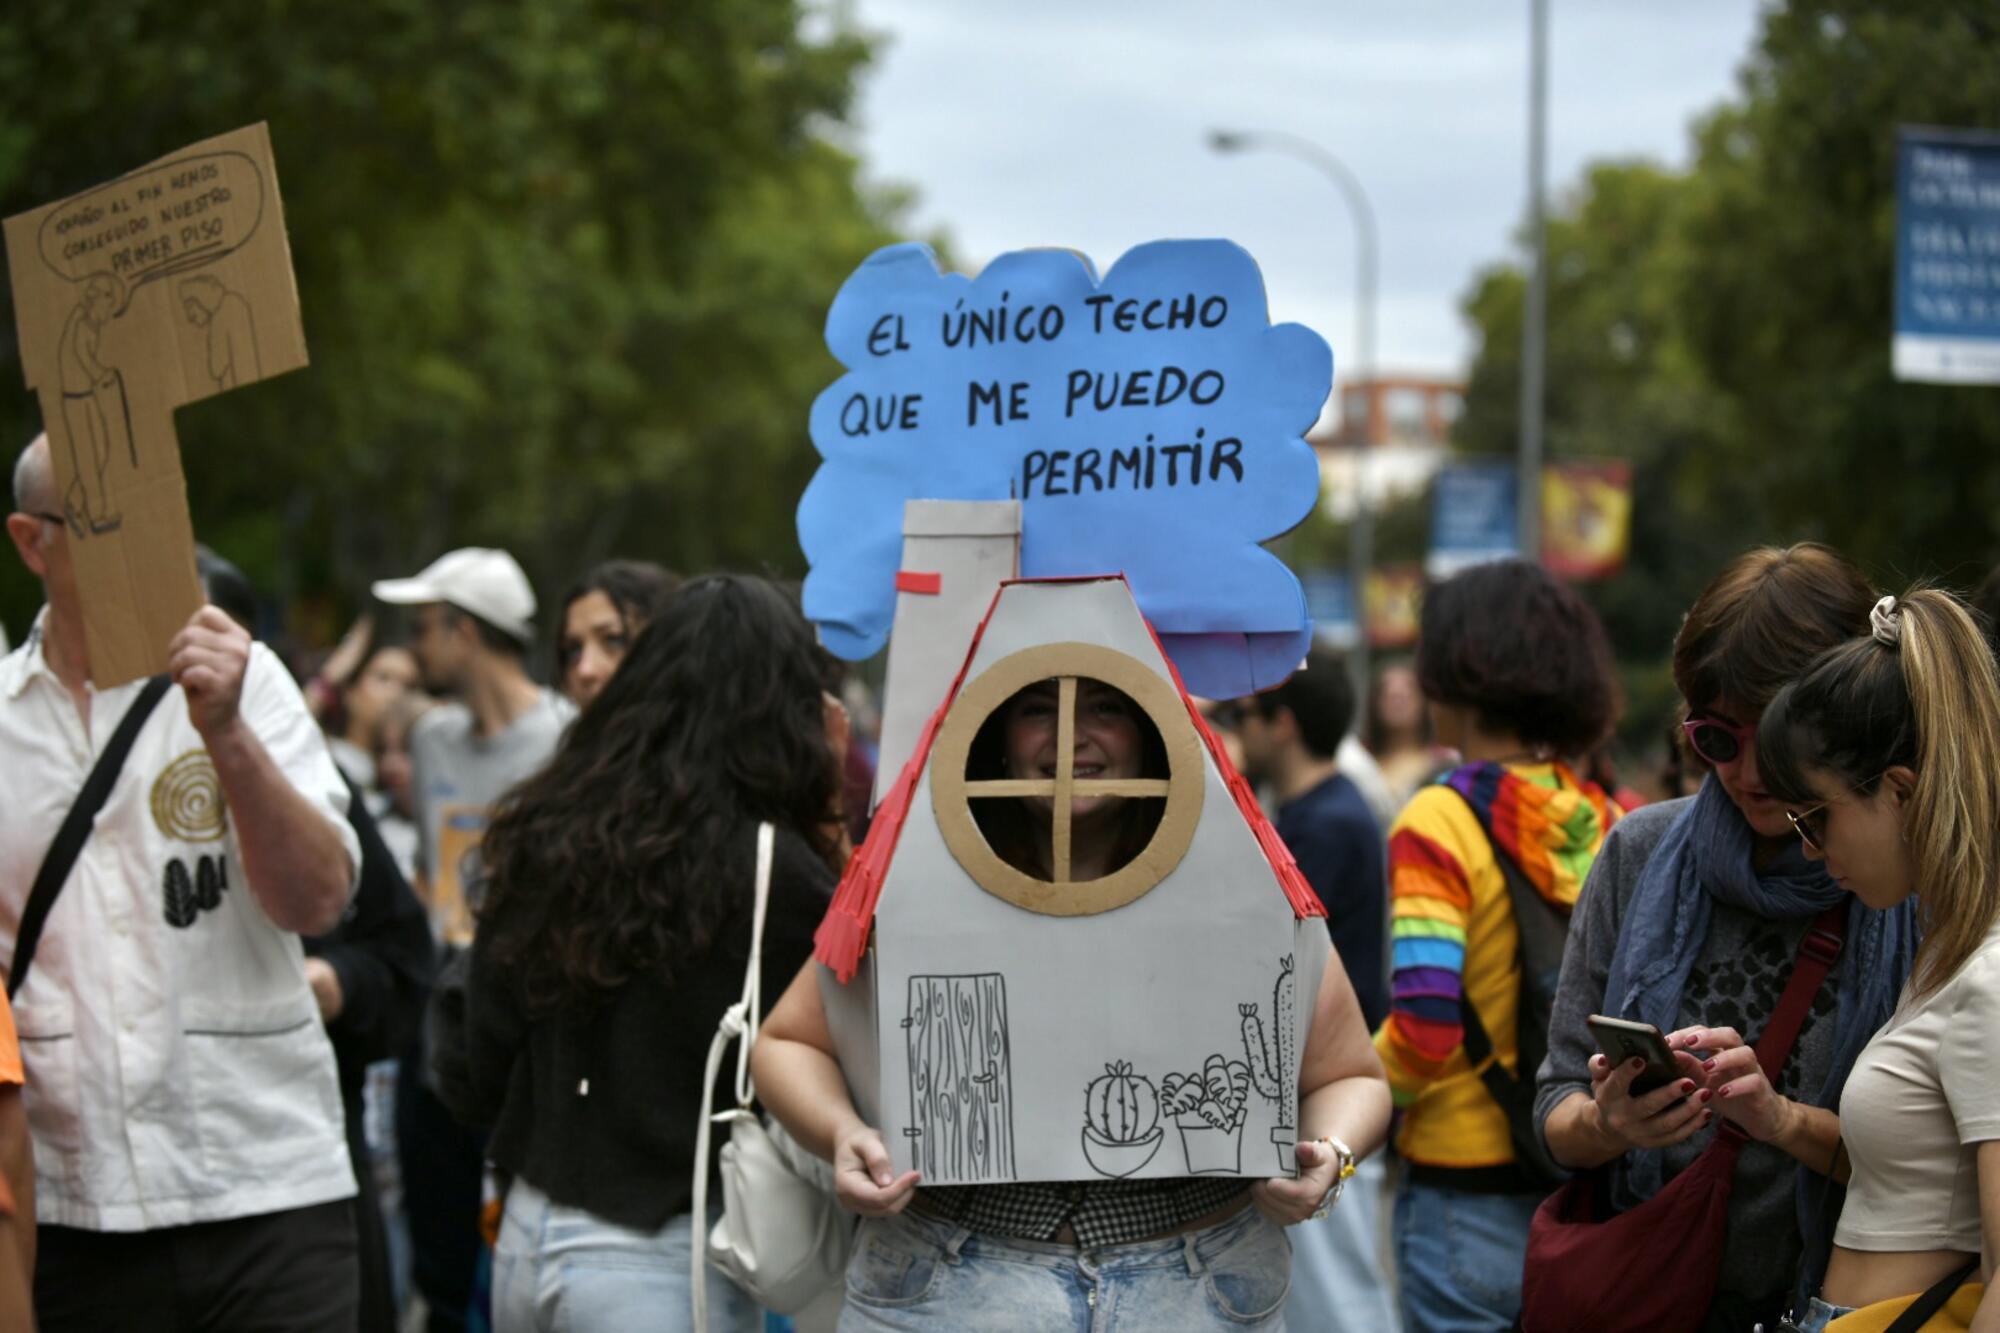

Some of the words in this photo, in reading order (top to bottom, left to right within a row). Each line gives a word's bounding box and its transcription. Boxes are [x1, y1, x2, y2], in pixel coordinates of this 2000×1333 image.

[111, 199, 130, 217] AL
[137, 183, 163, 203] FIN
[171, 162, 220, 190] HEMOS
[63, 216, 150, 261] CONSEGUIDO
[160, 187, 232, 223] NUESTRO
[112, 235, 173, 273] PRIMER
[182, 217, 223, 249] PISO
[868, 315, 909, 356] EL
[1085, 294, 1227, 333] TECHO
[842, 394, 921, 435] QUE
[969, 382, 1029, 426] ME
[1066, 367, 1224, 417] PUEDO
